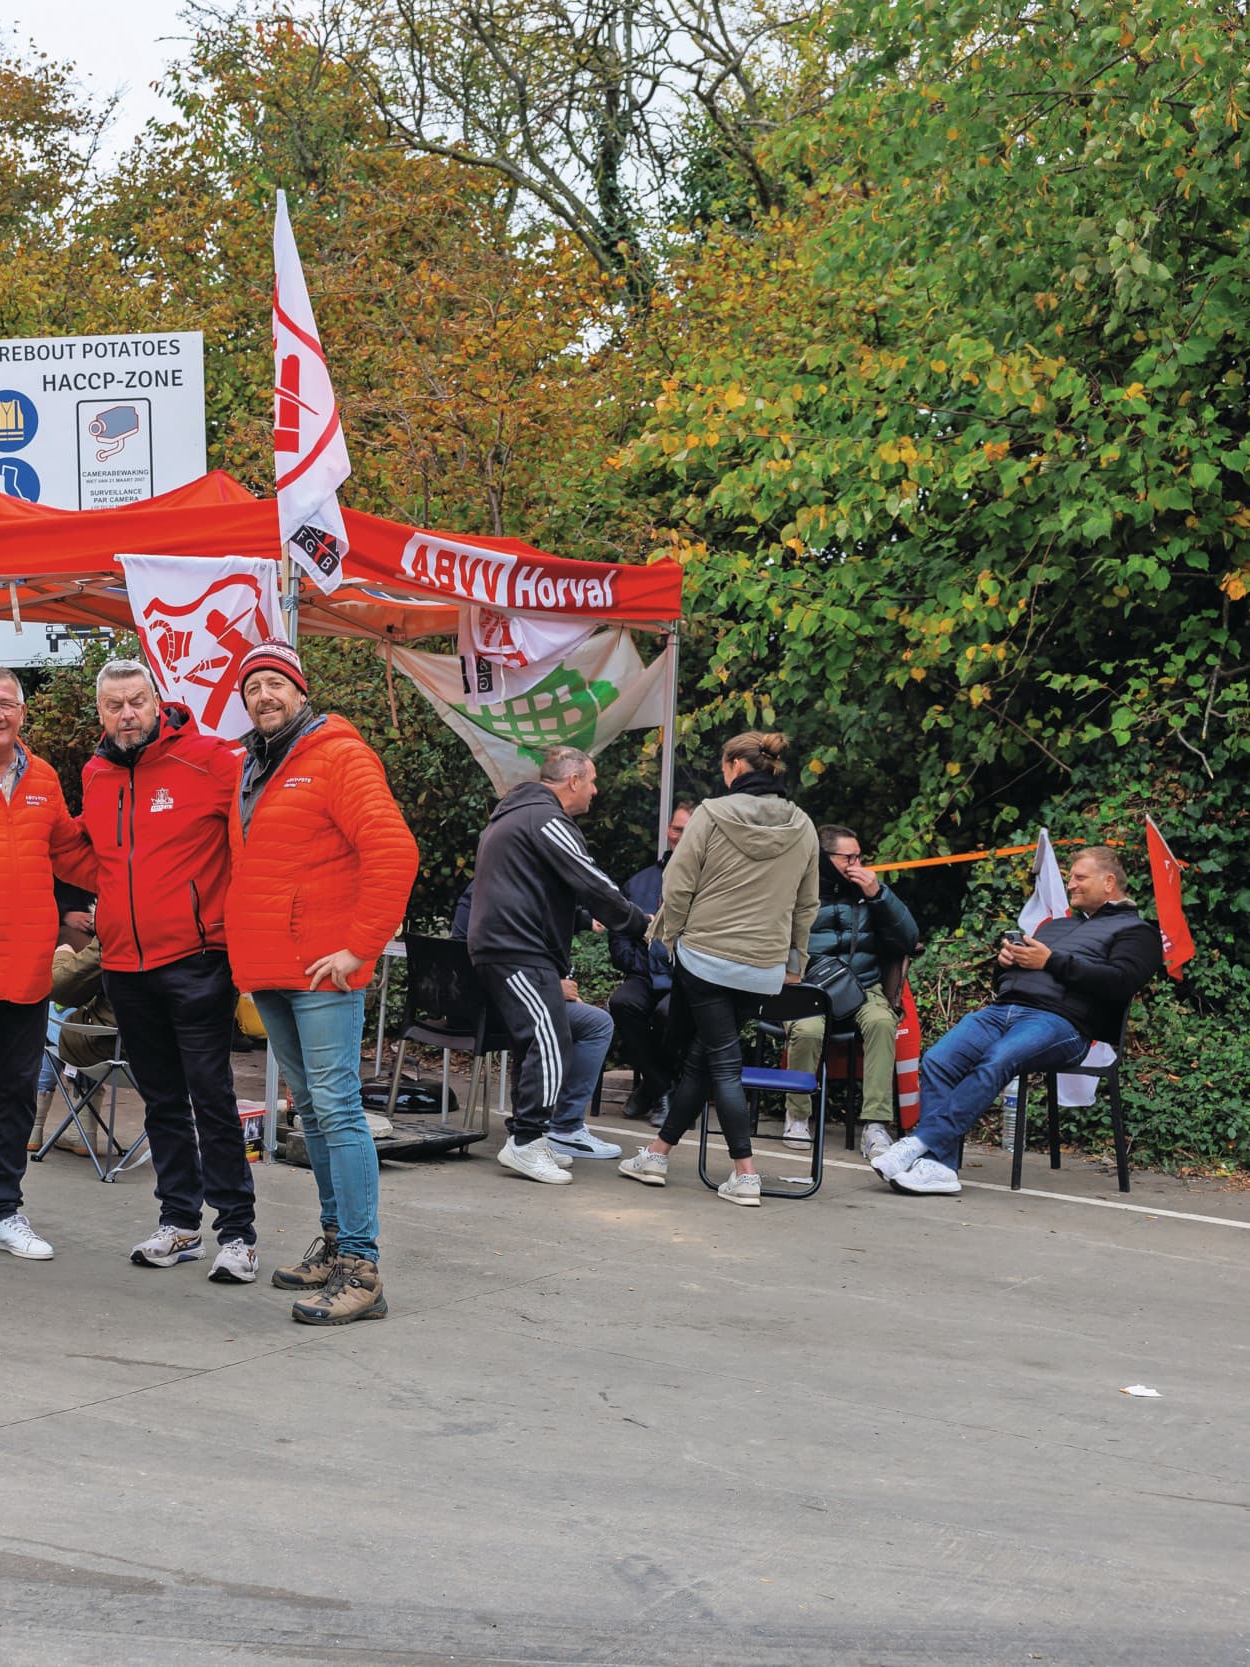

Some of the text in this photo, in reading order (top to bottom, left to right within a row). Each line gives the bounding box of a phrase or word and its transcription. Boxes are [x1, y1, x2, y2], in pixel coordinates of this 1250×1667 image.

[82, 339, 181, 359] POTATOES
[42, 369, 184, 392] HACCP-ZONE
[82, 469, 149, 477] CAMERABEWAKING
[90, 488, 142, 496] SURVEILLANCE
[296, 529, 333, 570] FGTB
[411, 544, 617, 609] ABVV Horval
